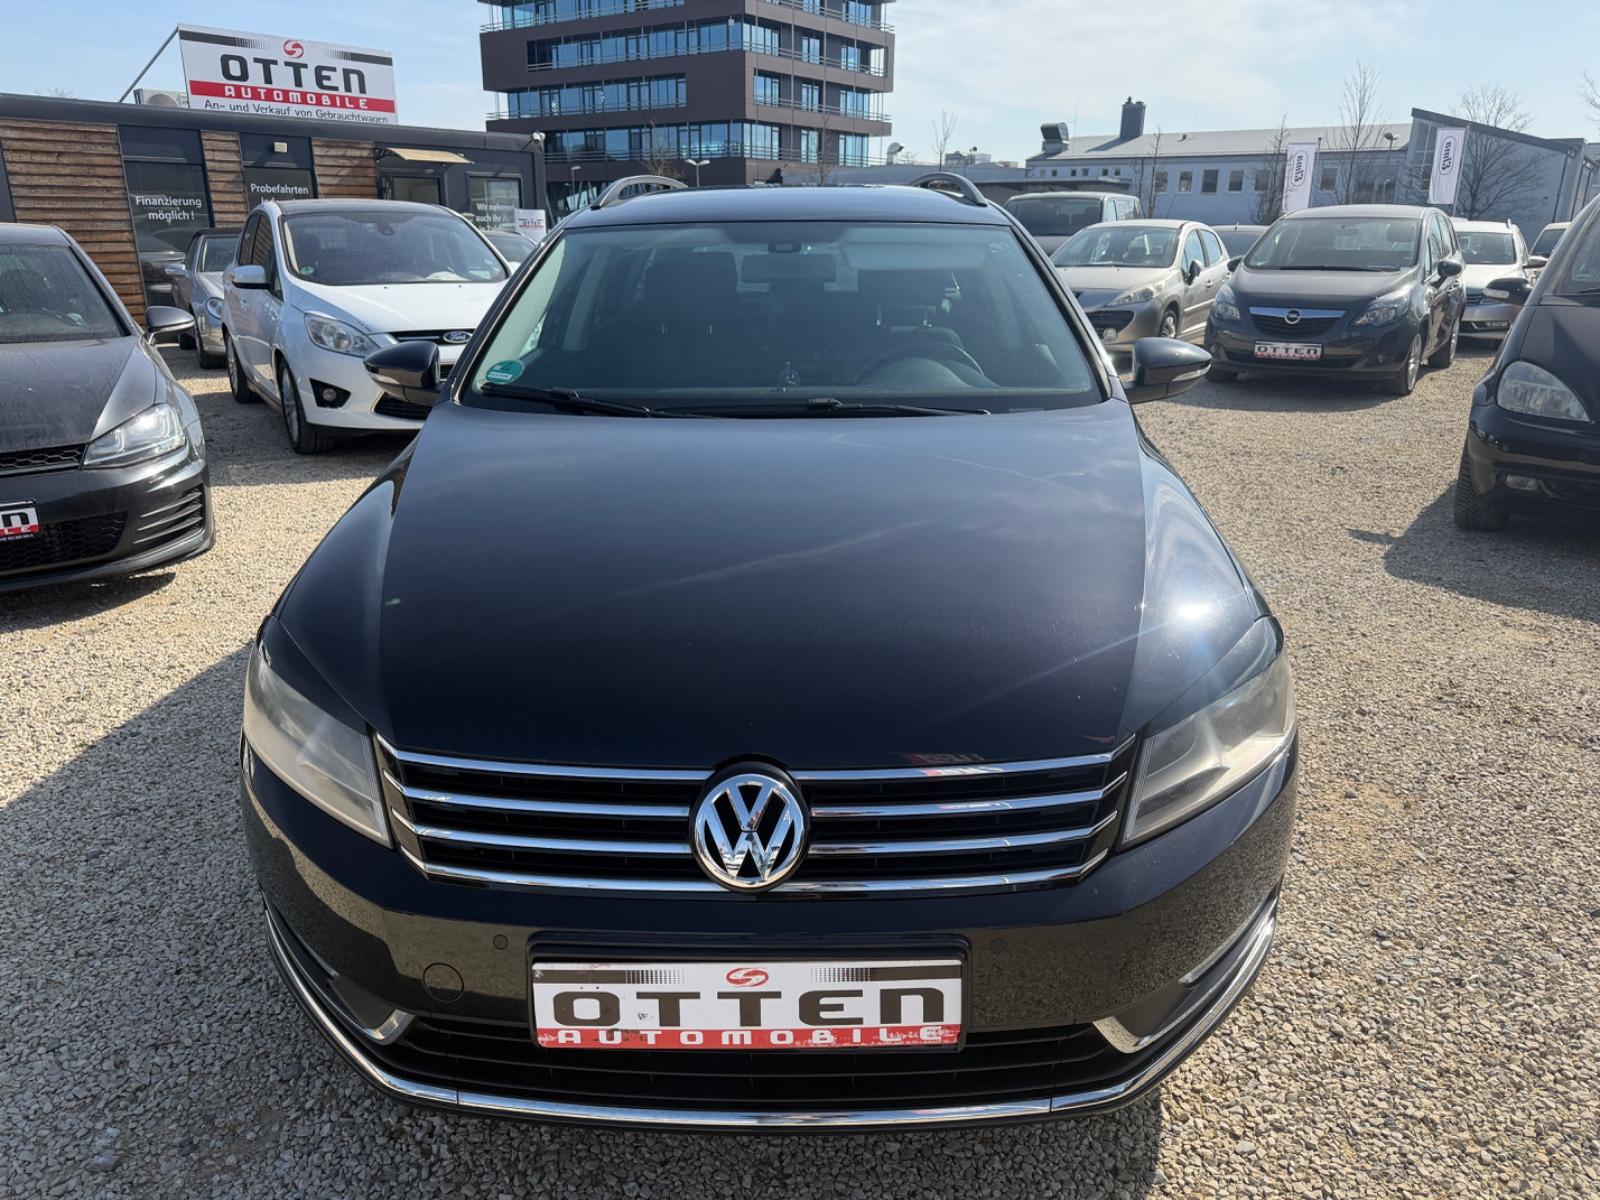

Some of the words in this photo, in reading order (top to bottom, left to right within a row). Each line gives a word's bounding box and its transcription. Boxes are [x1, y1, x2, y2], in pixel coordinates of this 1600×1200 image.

[224, 85, 369, 110] AUTOMOBILE
[204, 99, 226, 109] An-
[229, 103, 249, 112] und
[252, 103, 290, 115] Verkauf
[294, 109, 313, 117] von
[315, 109, 388, 123] Gebrauchtwagen
[250, 183, 309, 195] Probefahrten
[135, 195, 202, 208] Finanzierung
[148, 209, 190, 225] möglich
[557, 1025, 942, 1045] AUTOMOBILE
